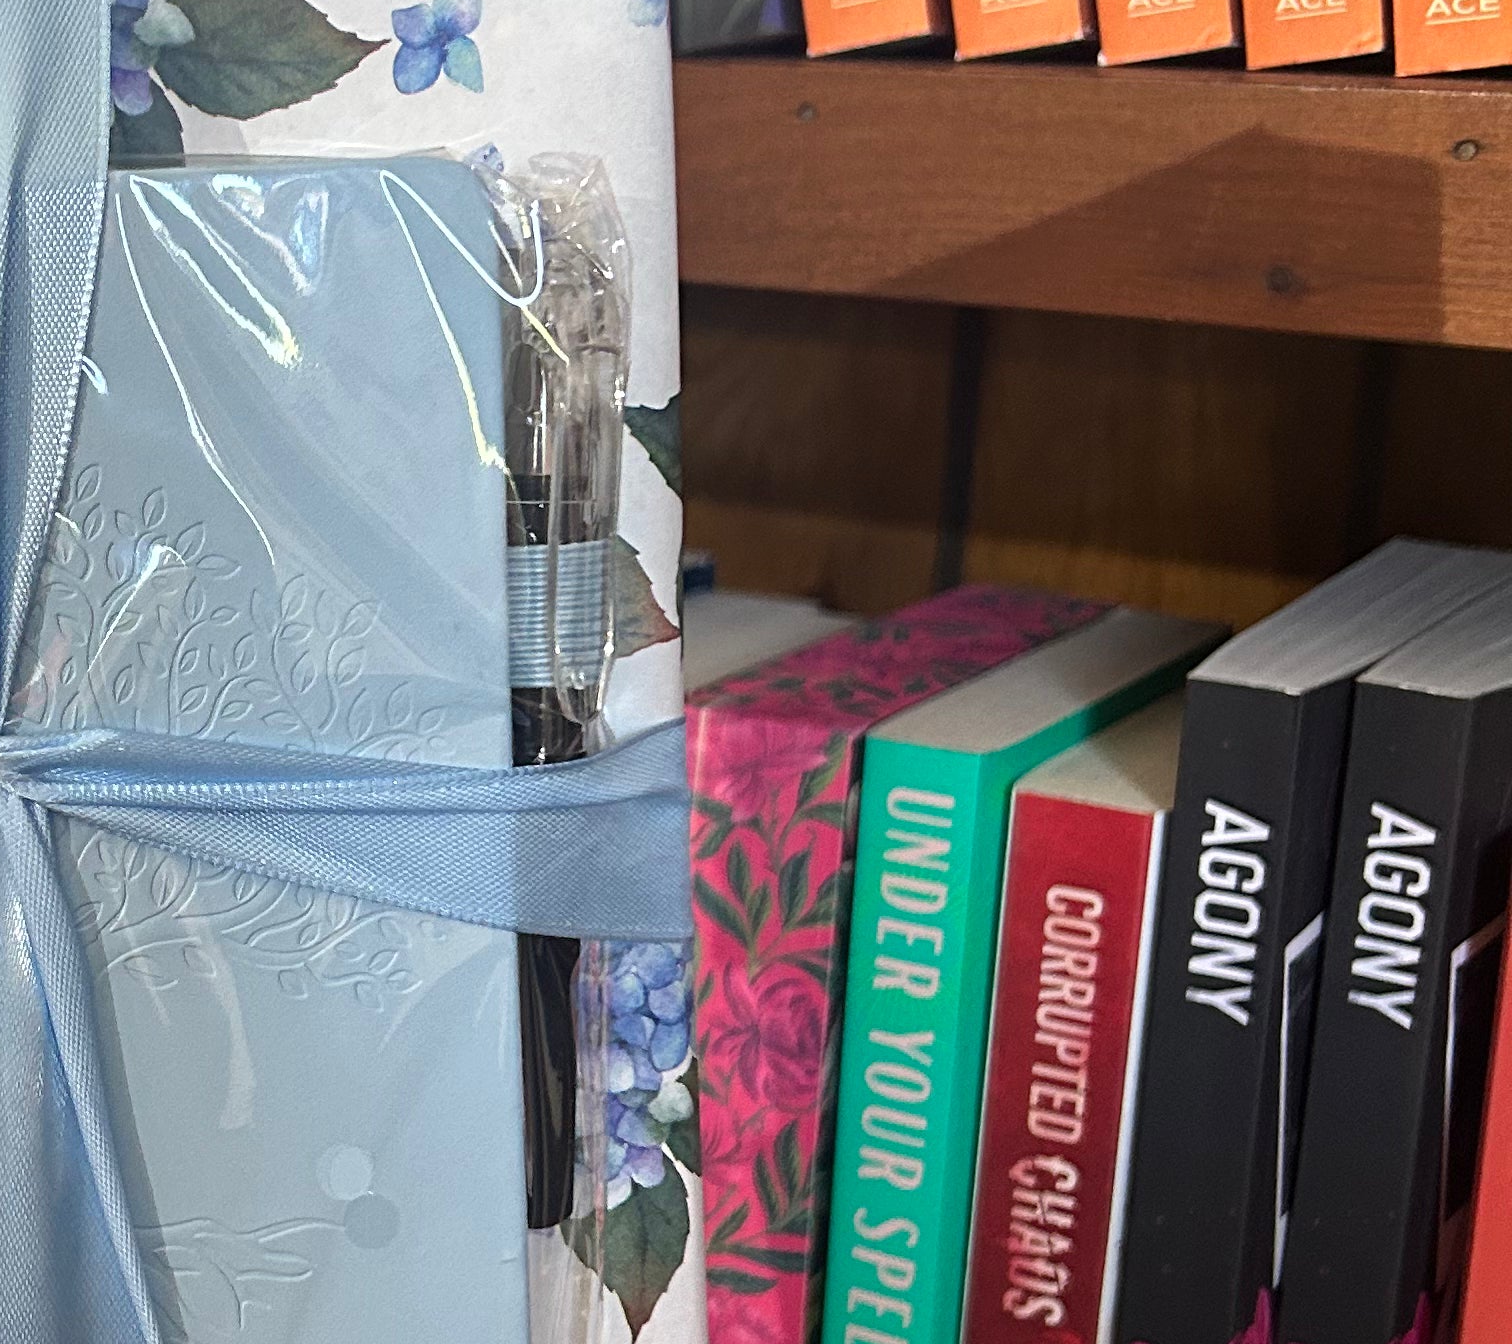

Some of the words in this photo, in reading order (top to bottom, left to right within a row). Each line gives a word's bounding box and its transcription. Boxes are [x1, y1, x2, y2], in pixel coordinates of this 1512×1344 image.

[871, 786, 956, 999] UNDER
[1186, 798, 1270, 1026] AGONY
[1348, 802, 1436, 1030] AGONY
[856, 1027, 935, 1191] YOUR
[1026, 884, 1105, 1145] CORRUPTED
[1000, 1154, 1080, 1328] CHAOS
